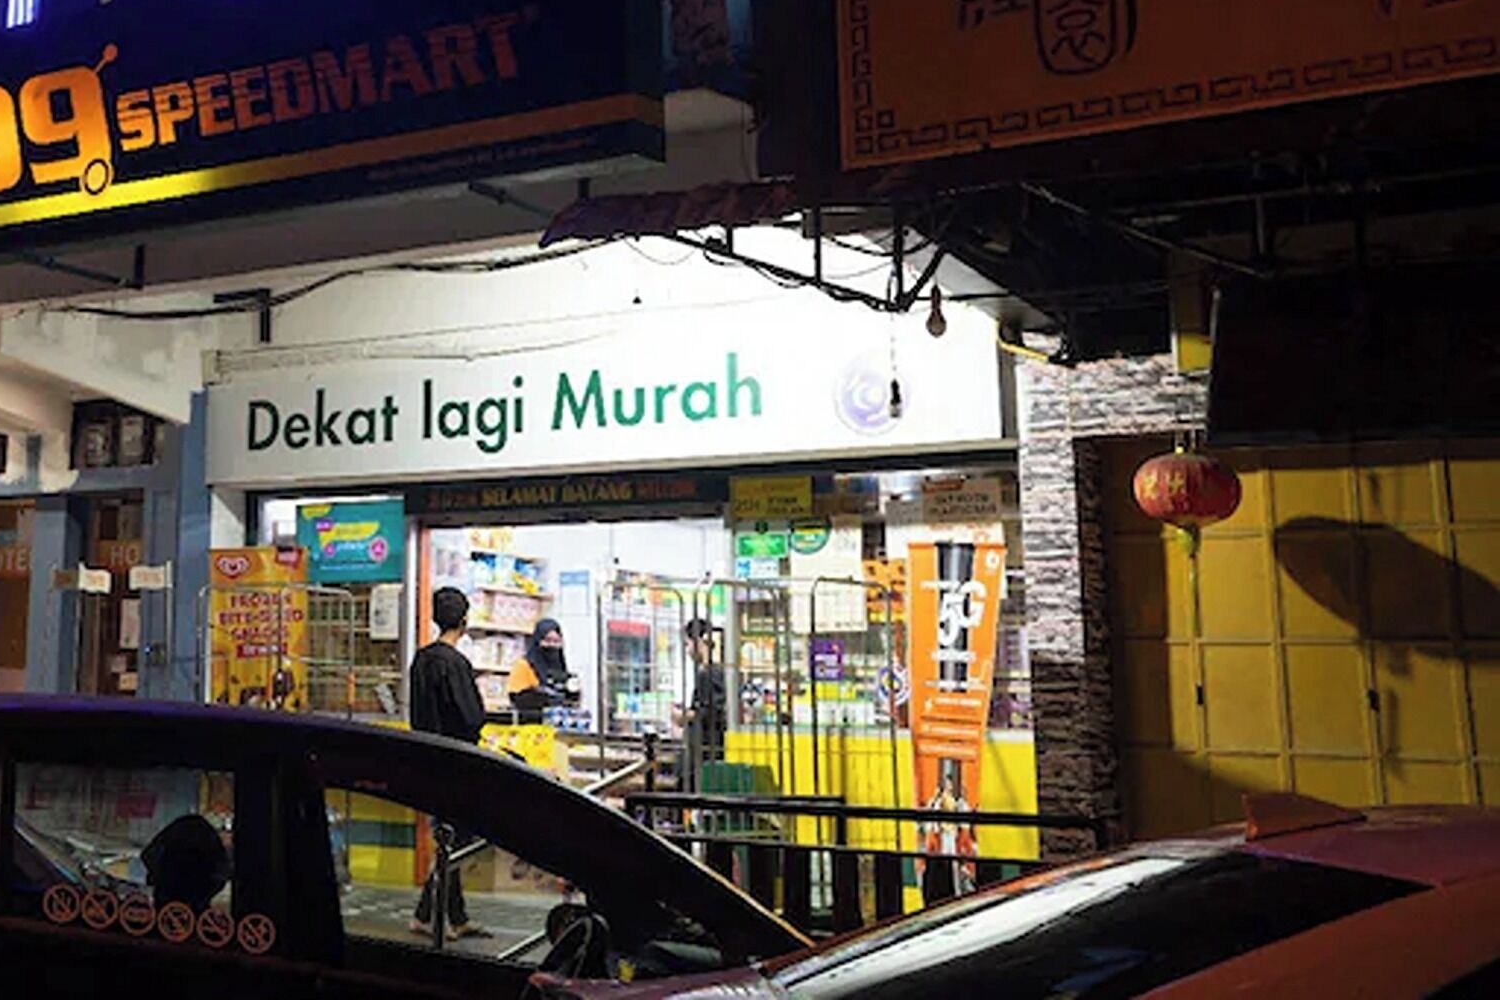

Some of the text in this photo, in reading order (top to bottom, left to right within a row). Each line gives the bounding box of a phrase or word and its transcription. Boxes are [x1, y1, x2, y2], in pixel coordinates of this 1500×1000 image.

[116, 12, 528, 151] SPEEDMART
[247, 350, 764, 454] Dekat lagi Murah
[938, 579, 987, 647] 5G
